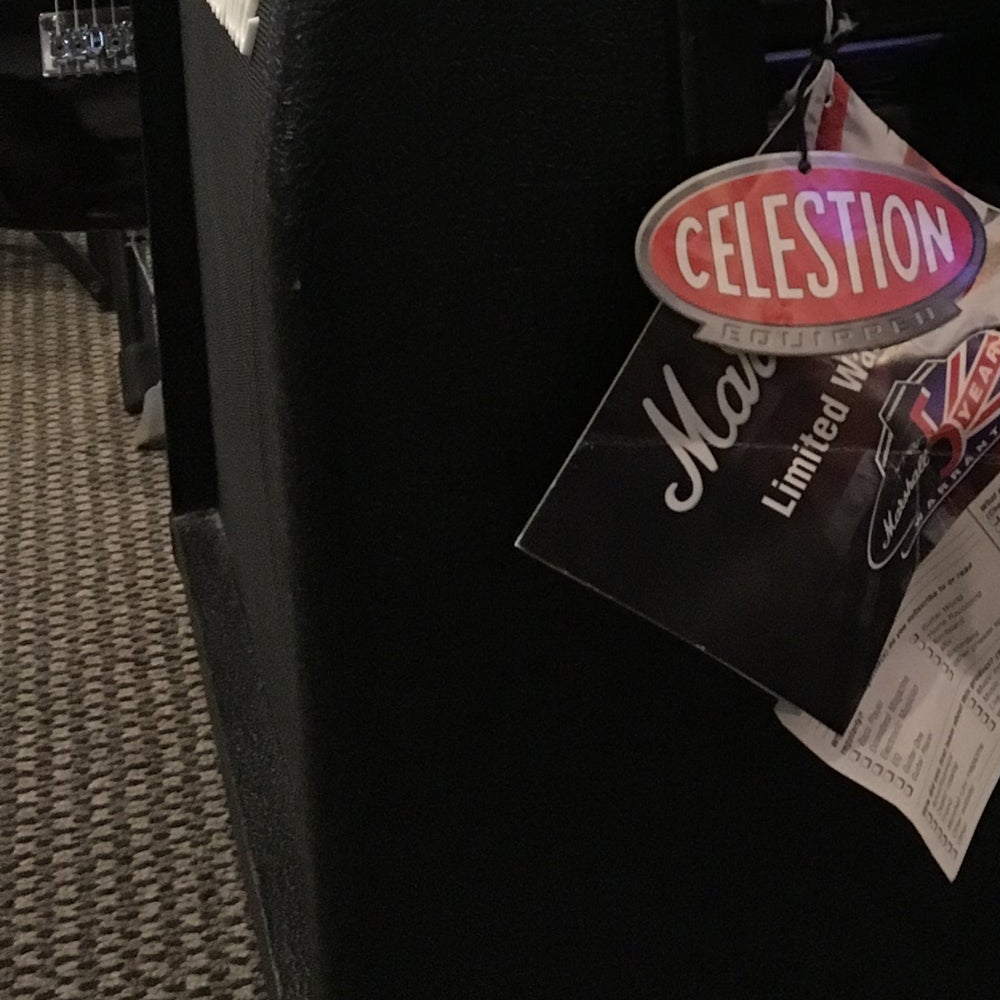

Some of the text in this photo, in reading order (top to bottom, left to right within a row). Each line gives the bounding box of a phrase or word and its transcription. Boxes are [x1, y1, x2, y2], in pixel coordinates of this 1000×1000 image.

[675, 190, 955, 299] CELESTION
[642, 354, 777, 513] Mar
[761, 350, 879, 518] Limited Wa
[881, 446, 933, 550] Marshall
